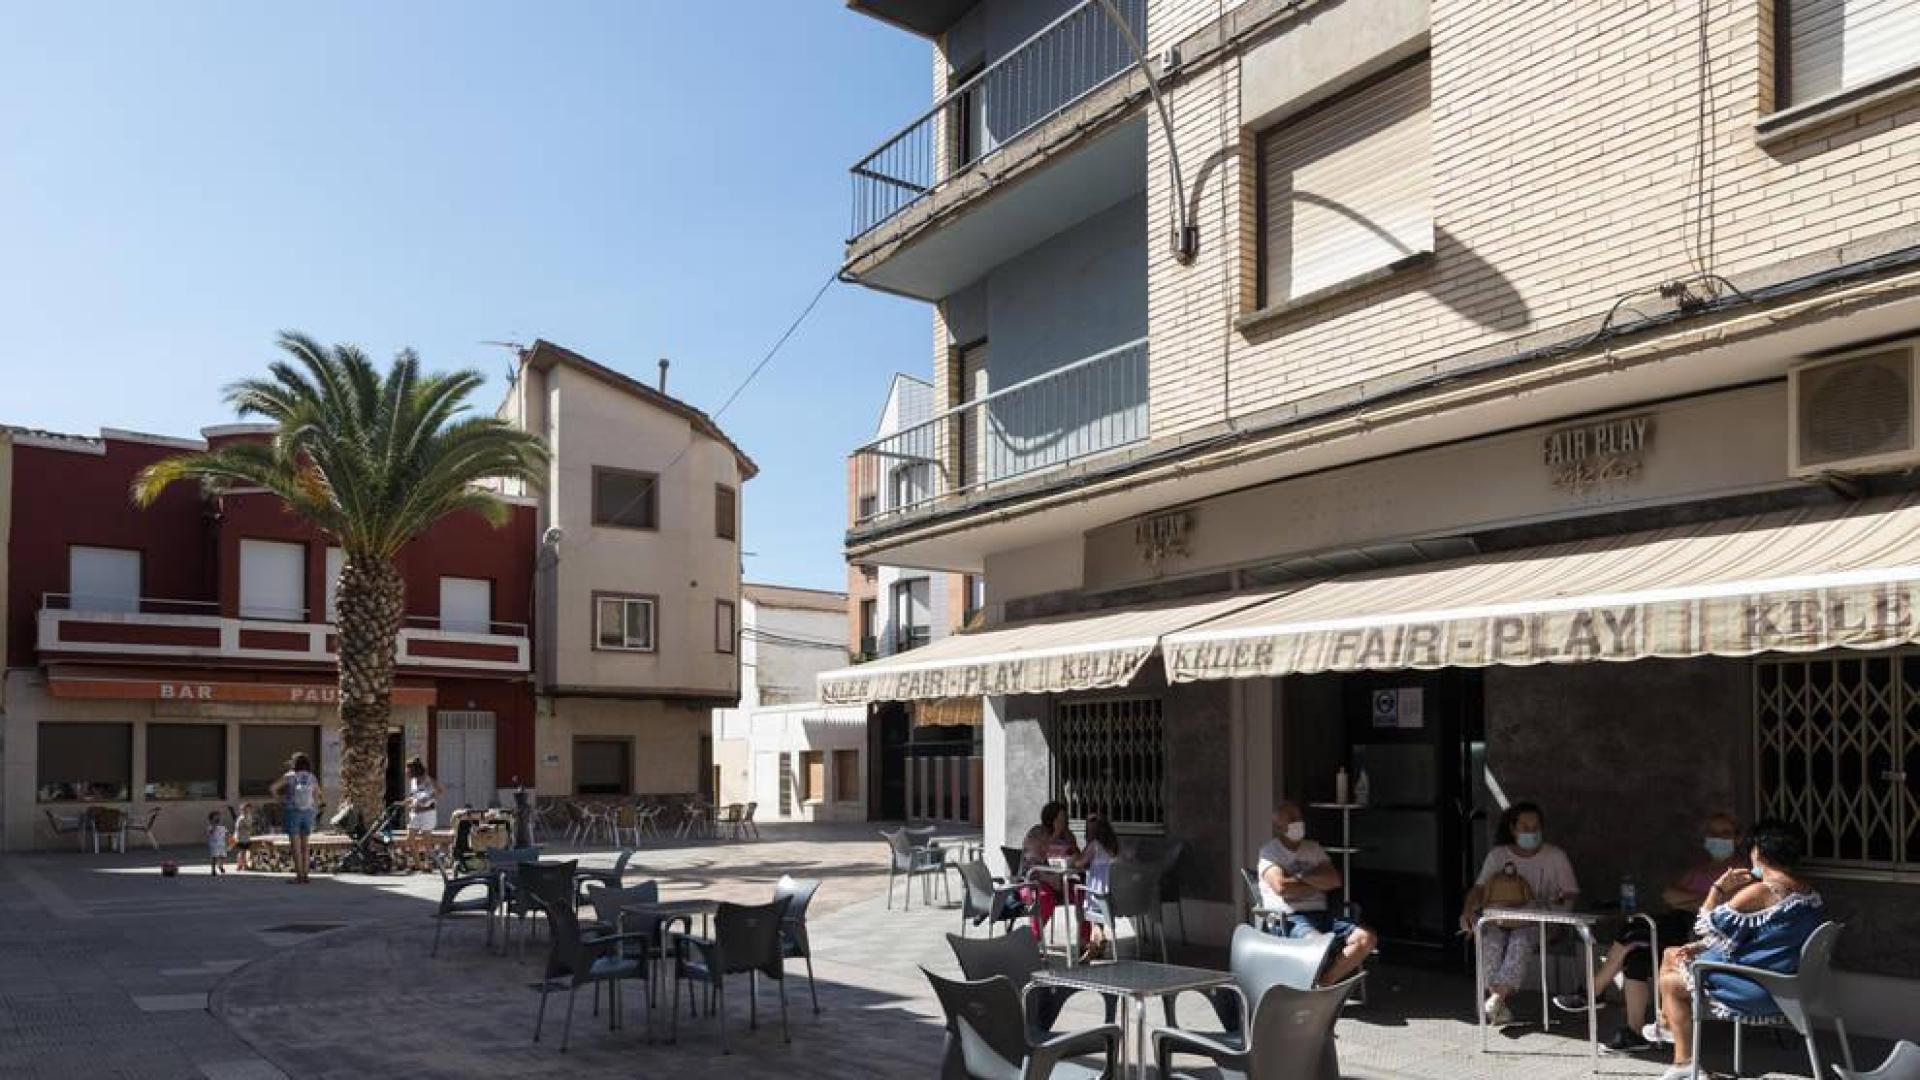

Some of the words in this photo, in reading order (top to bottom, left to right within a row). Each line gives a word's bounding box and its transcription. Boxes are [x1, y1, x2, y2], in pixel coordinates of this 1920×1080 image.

[1538, 429, 1586, 466] FAIR
[1595, 417, 1647, 457] PLAY
[1172, 640, 1273, 670] KELER
[1743, 590, 1920, 636] KELE
[160, 683, 214, 699] BAR
[290, 687, 339, 702] PAU
